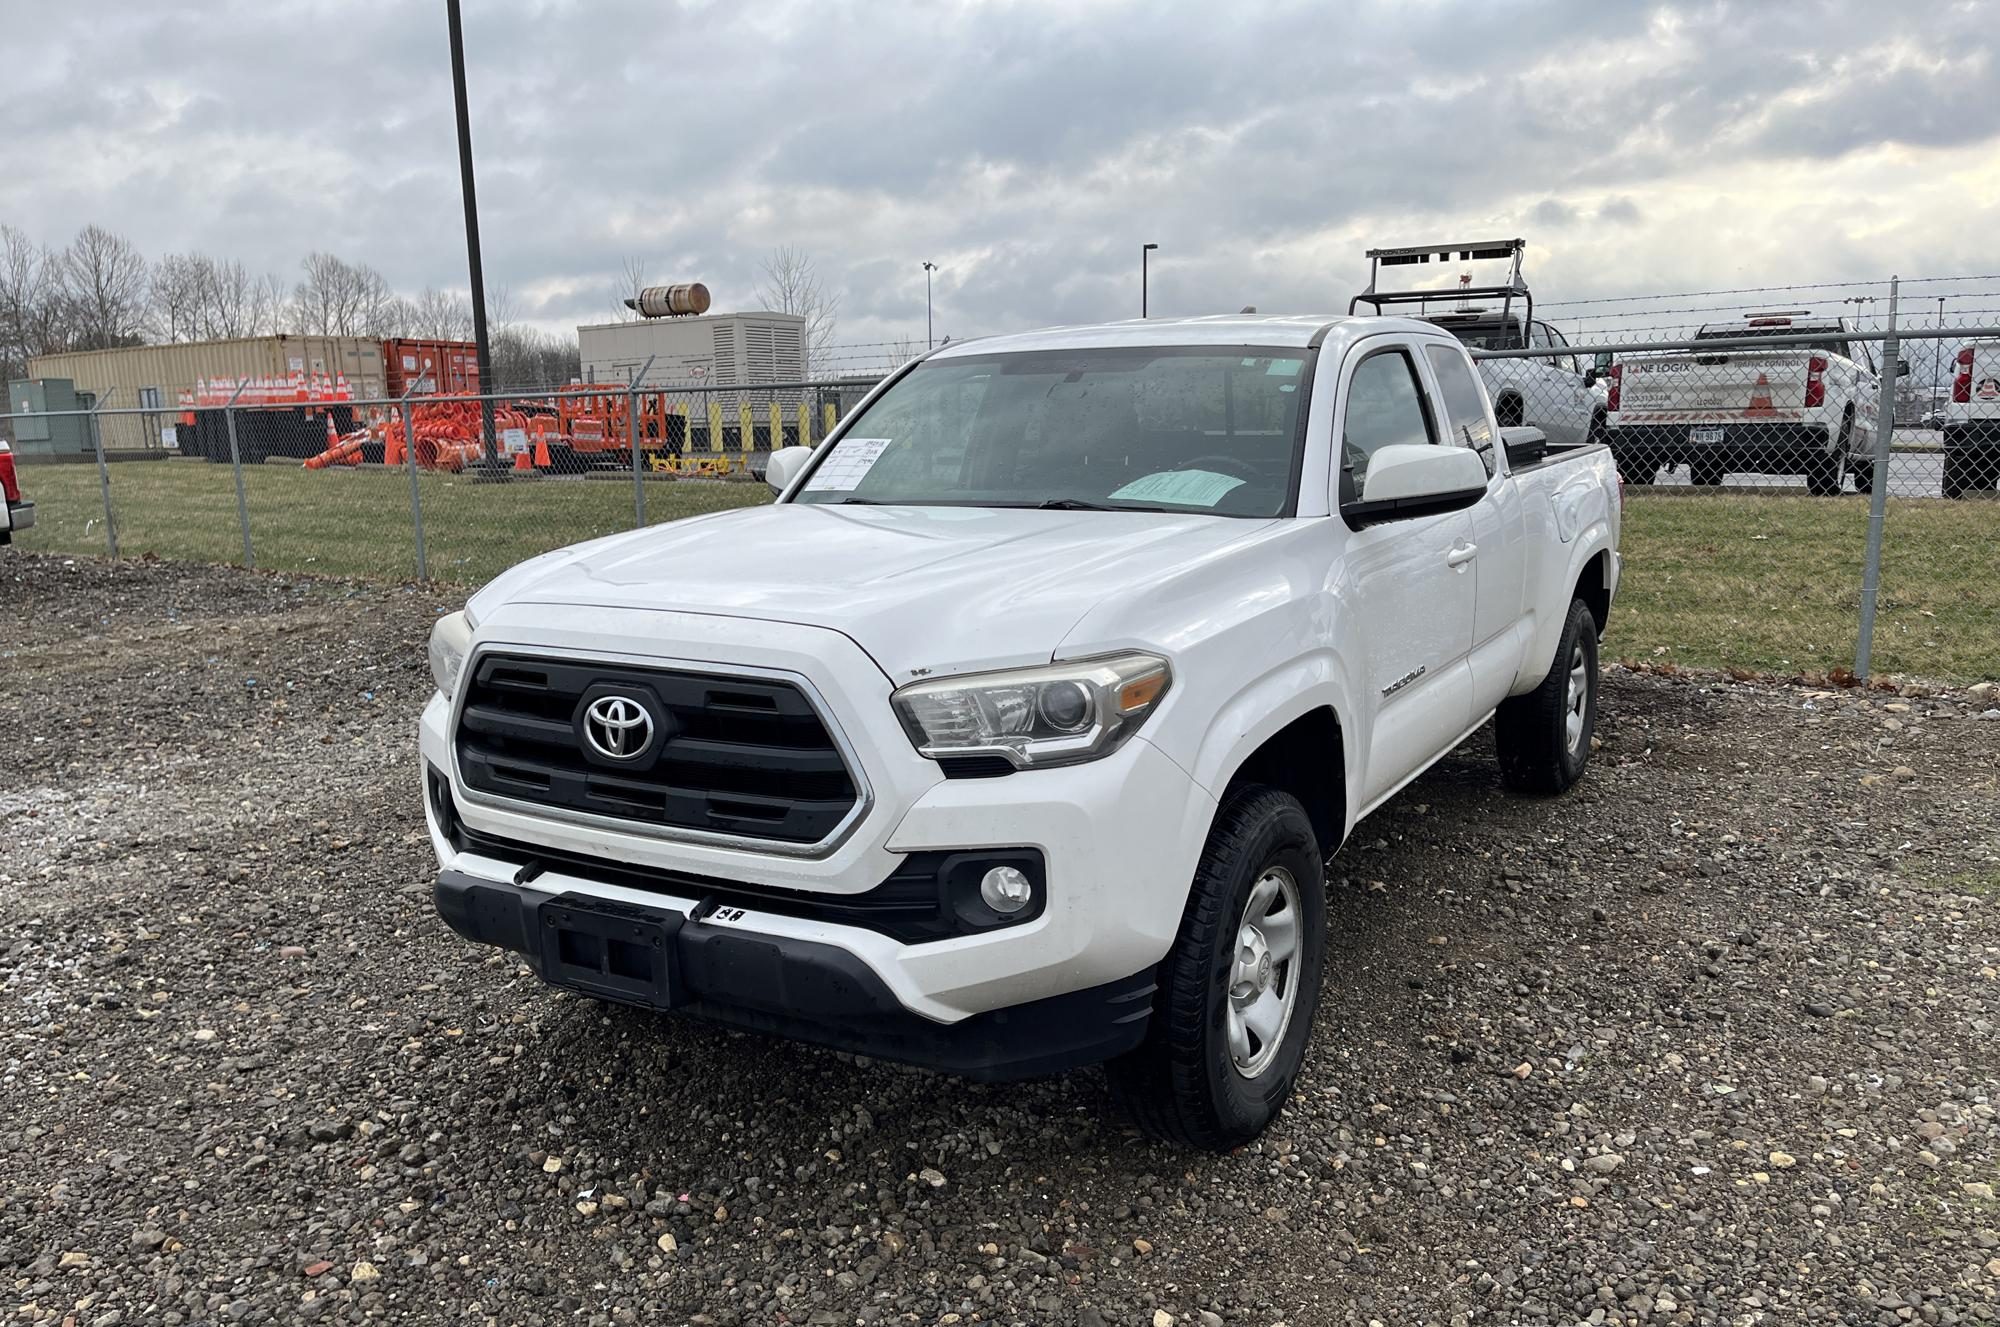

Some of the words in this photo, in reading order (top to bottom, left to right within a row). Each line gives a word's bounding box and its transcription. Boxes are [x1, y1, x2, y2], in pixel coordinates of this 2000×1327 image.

[1657, 363, 1691, 373] LOGIX
[1764, 359, 1801, 368] CONTROL
[1381, 664, 1426, 699] TACOMA
